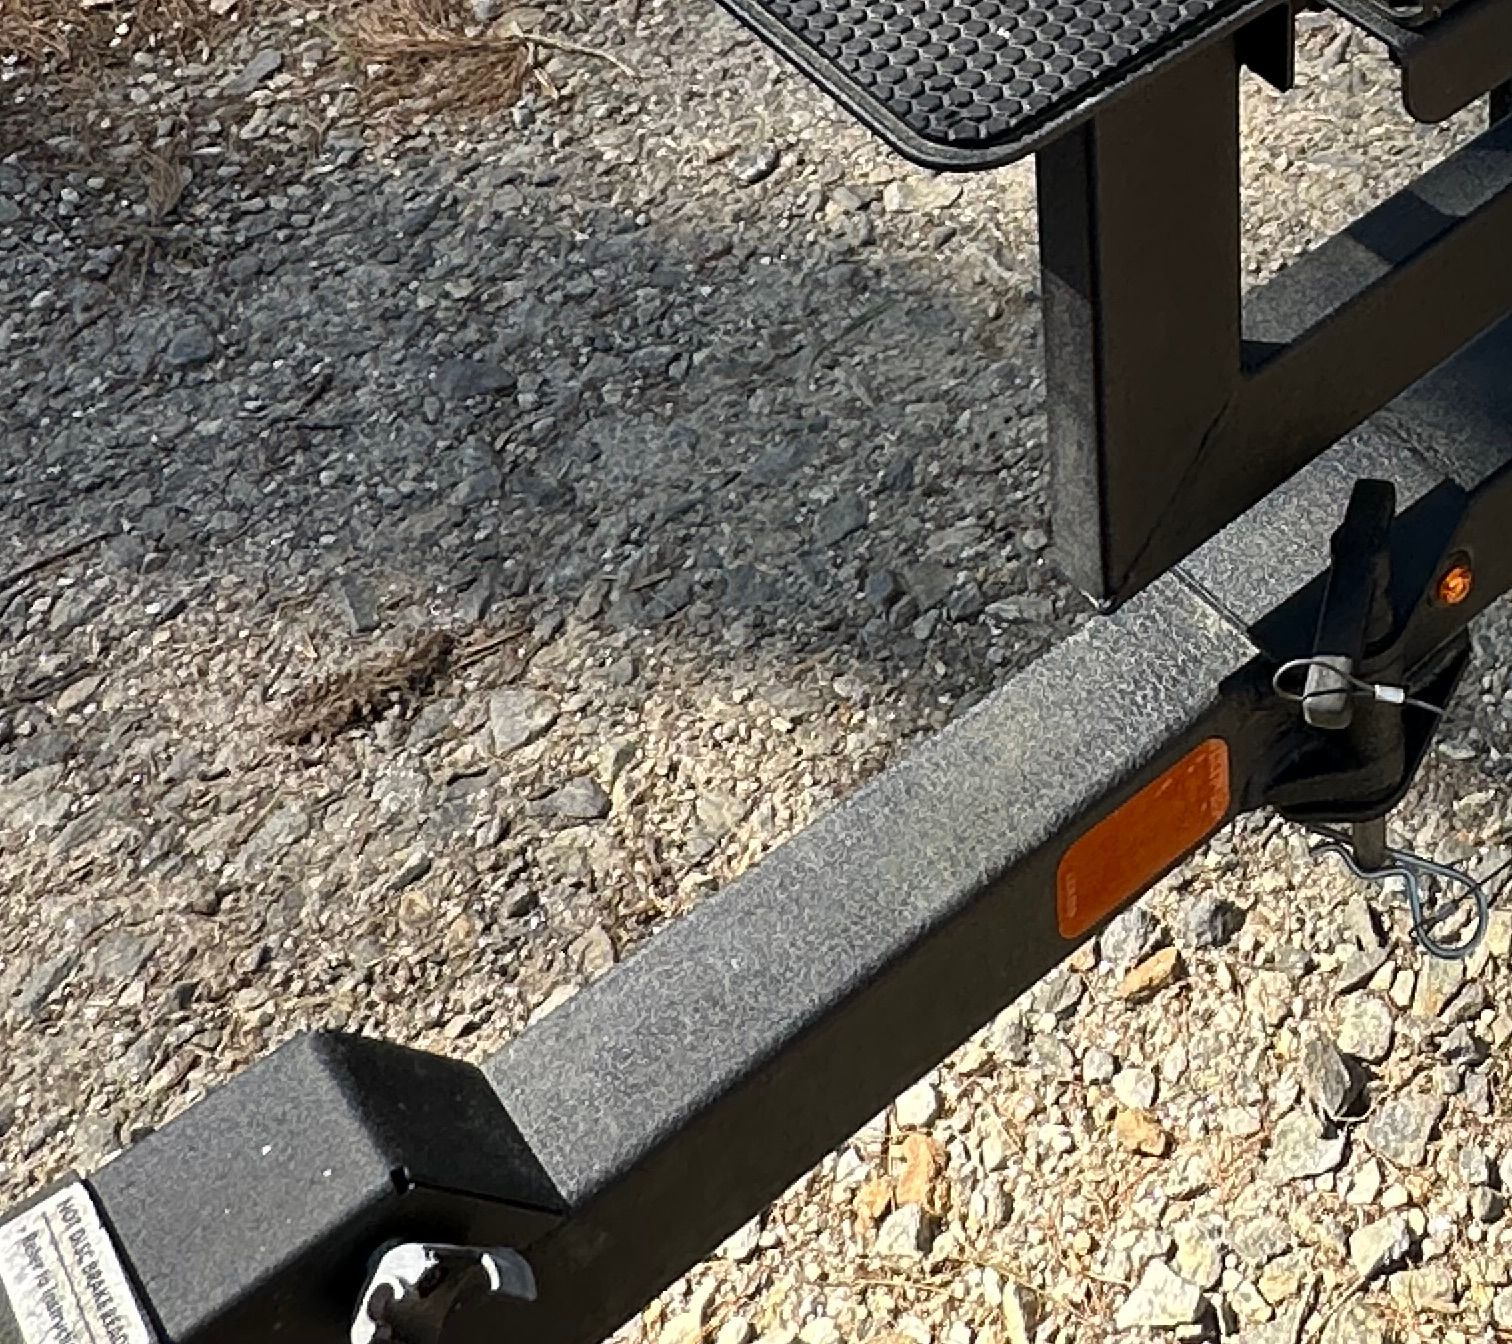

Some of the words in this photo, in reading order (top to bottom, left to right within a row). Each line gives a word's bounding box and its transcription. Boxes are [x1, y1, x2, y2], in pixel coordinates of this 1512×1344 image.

[56, 1195, 82, 1232] NOT
[69, 1226, 95, 1266] DISC
[81, 1260, 114, 1311] BRAKE
